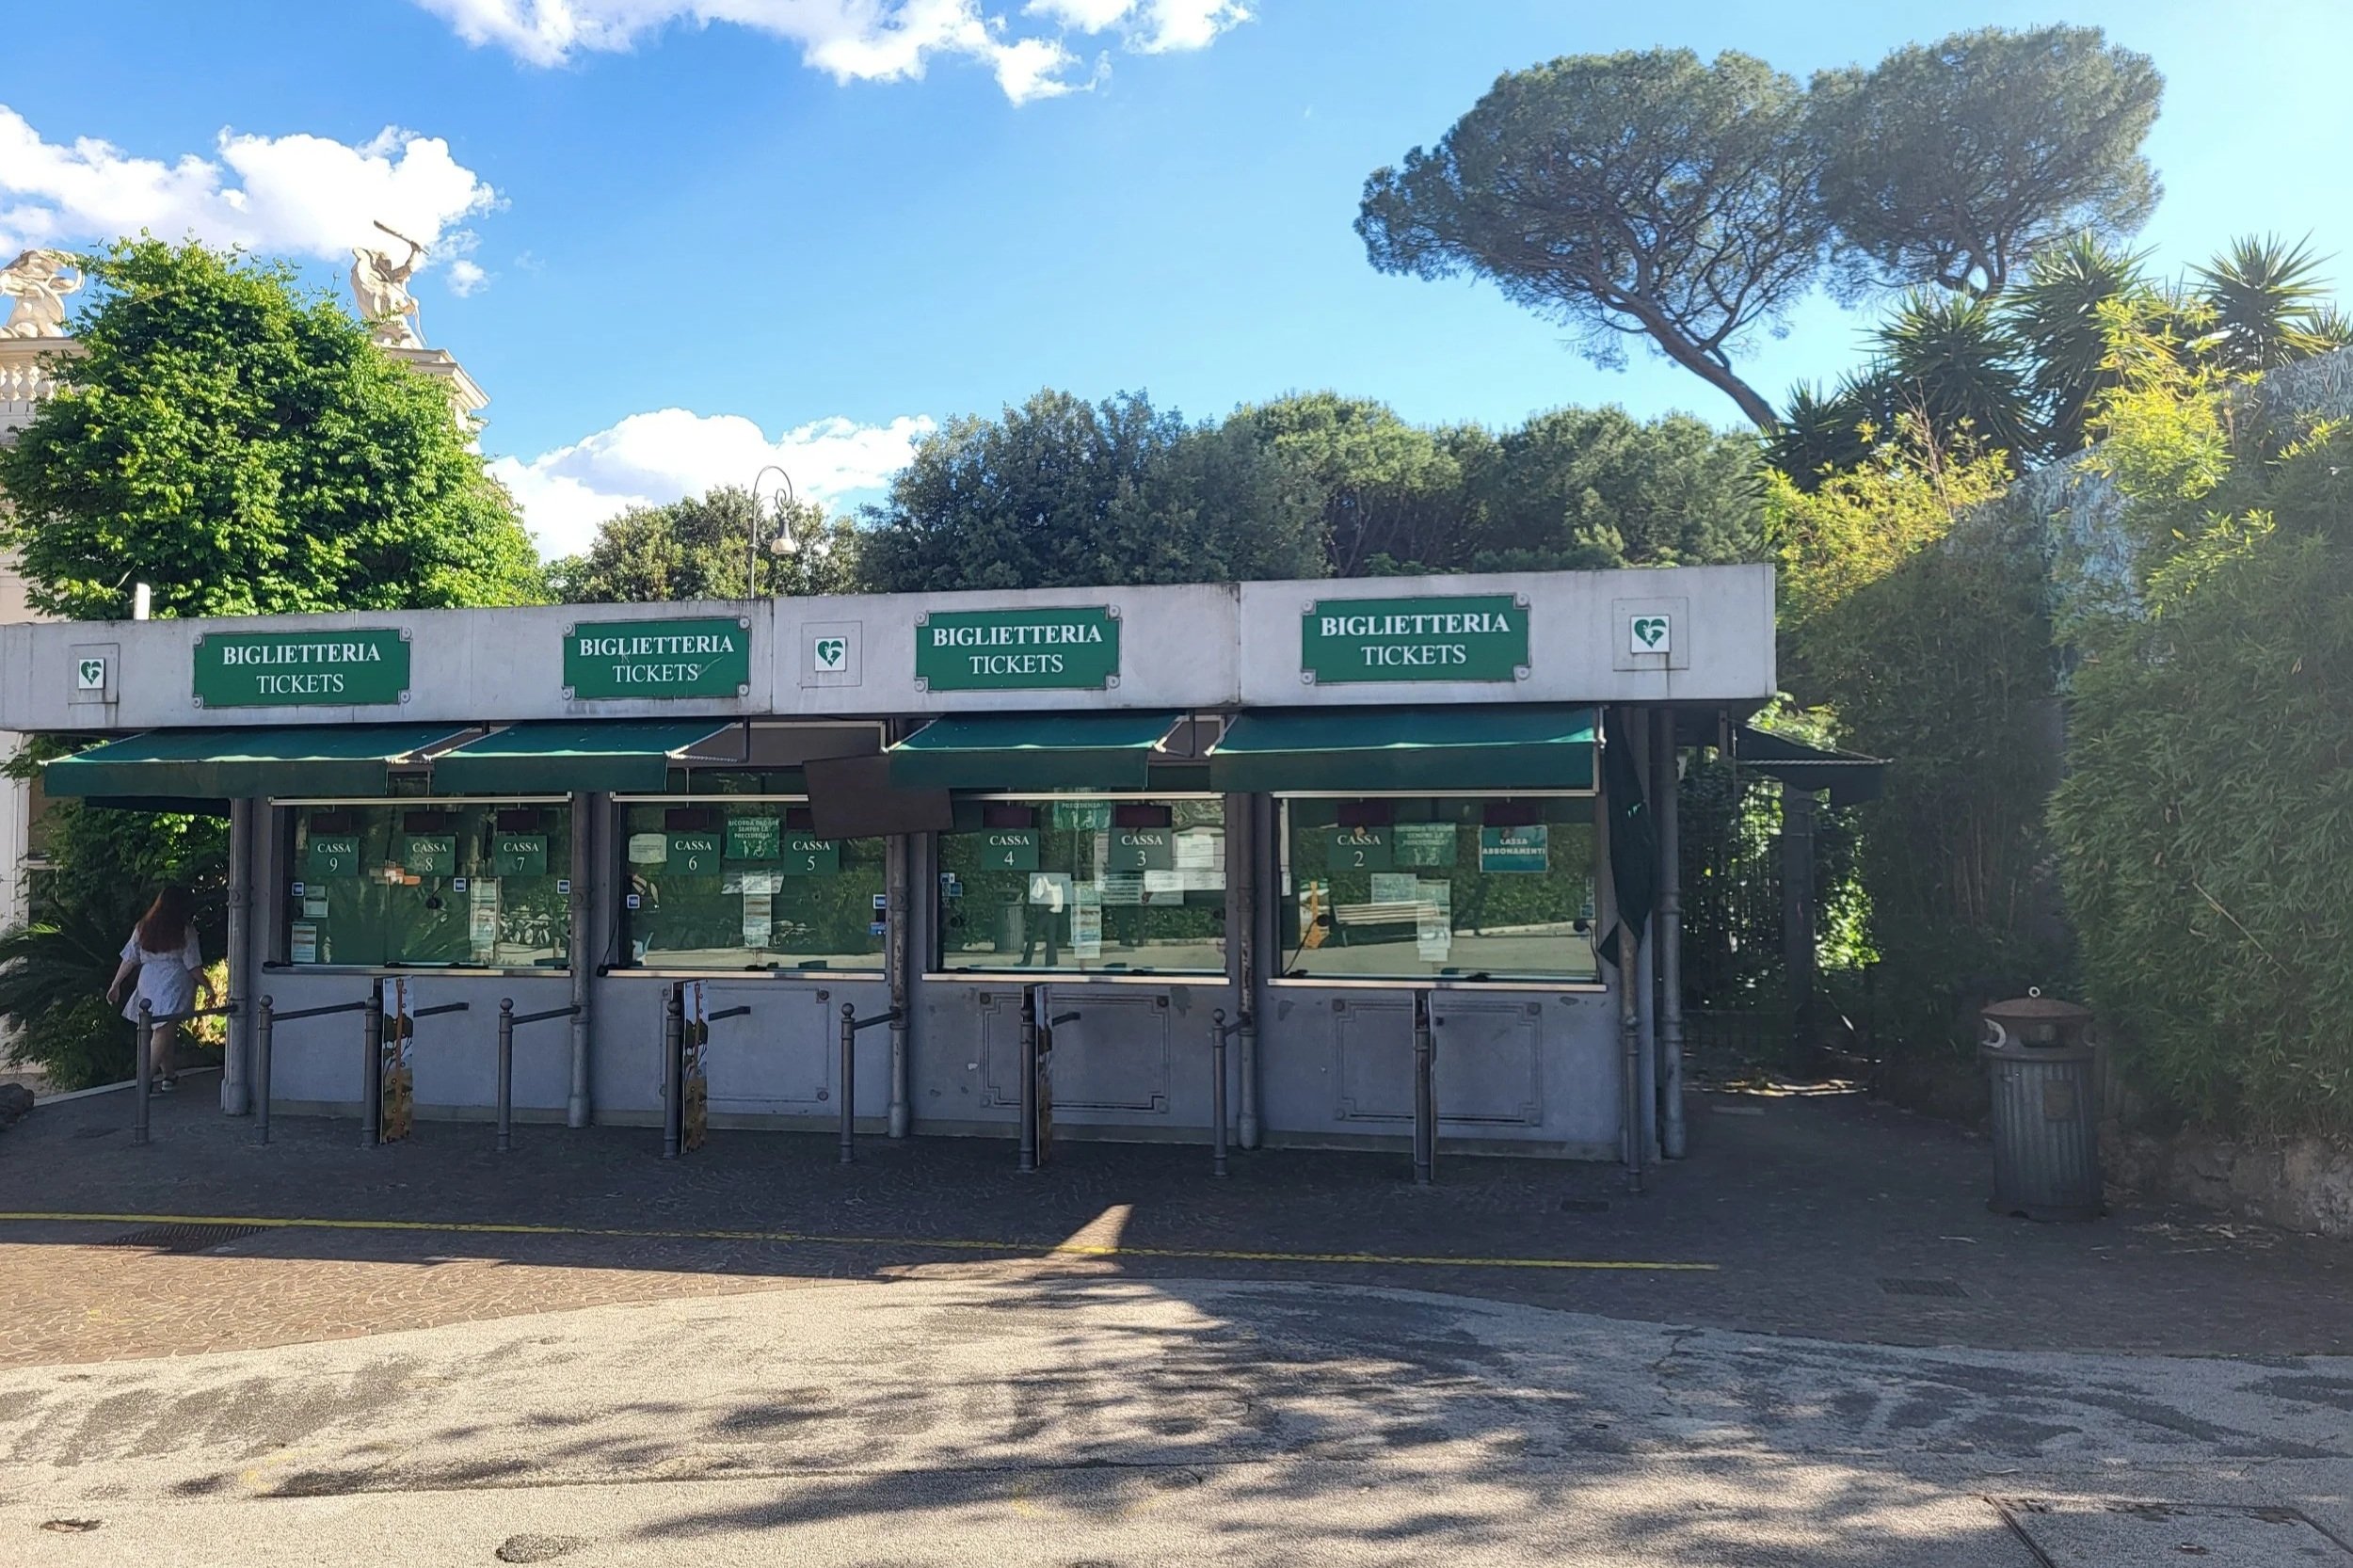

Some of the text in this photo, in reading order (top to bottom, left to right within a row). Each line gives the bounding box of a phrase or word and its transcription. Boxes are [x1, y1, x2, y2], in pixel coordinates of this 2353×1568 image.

[1320, 613, 1512, 637] BIGLIETTERIA
[932, 623, 1104, 648] BIGLIETTERIA
[579, 634, 734, 657] BIGLIETTERIA
[222, 642, 381, 666] BIGLIETTERIA
[1360, 644, 1467, 666] TICKETS
[968, 653, 1064, 675] TICKETS
[612, 663, 699, 683] TICKETS
[256, 673, 345, 695] TICKETS
[503, 842, 539, 853] CASSA
[675, 840, 712, 852] CASSA
[792, 840, 831, 852] CASSA
[989, 835, 1030, 846] CASSA
[1121, 834, 1163, 845] CASSA
[1337, 834, 1381, 845] CASSA
[317, 843, 352, 854] CASSA
[412, 842, 447, 854] CASSA
[1482, 847, 1545, 856] ABBONAMENTI
[329, 857, 339, 872] 9
[424, 856, 434, 872] 8
[517, 856, 526, 872] 7
[688, 856, 697, 871] 6
[807, 856, 816, 872] 5
[1003, 851, 1015, 867] 4
[1137, 850, 1147, 866] 3
[1353, 851, 1365, 866] 2
